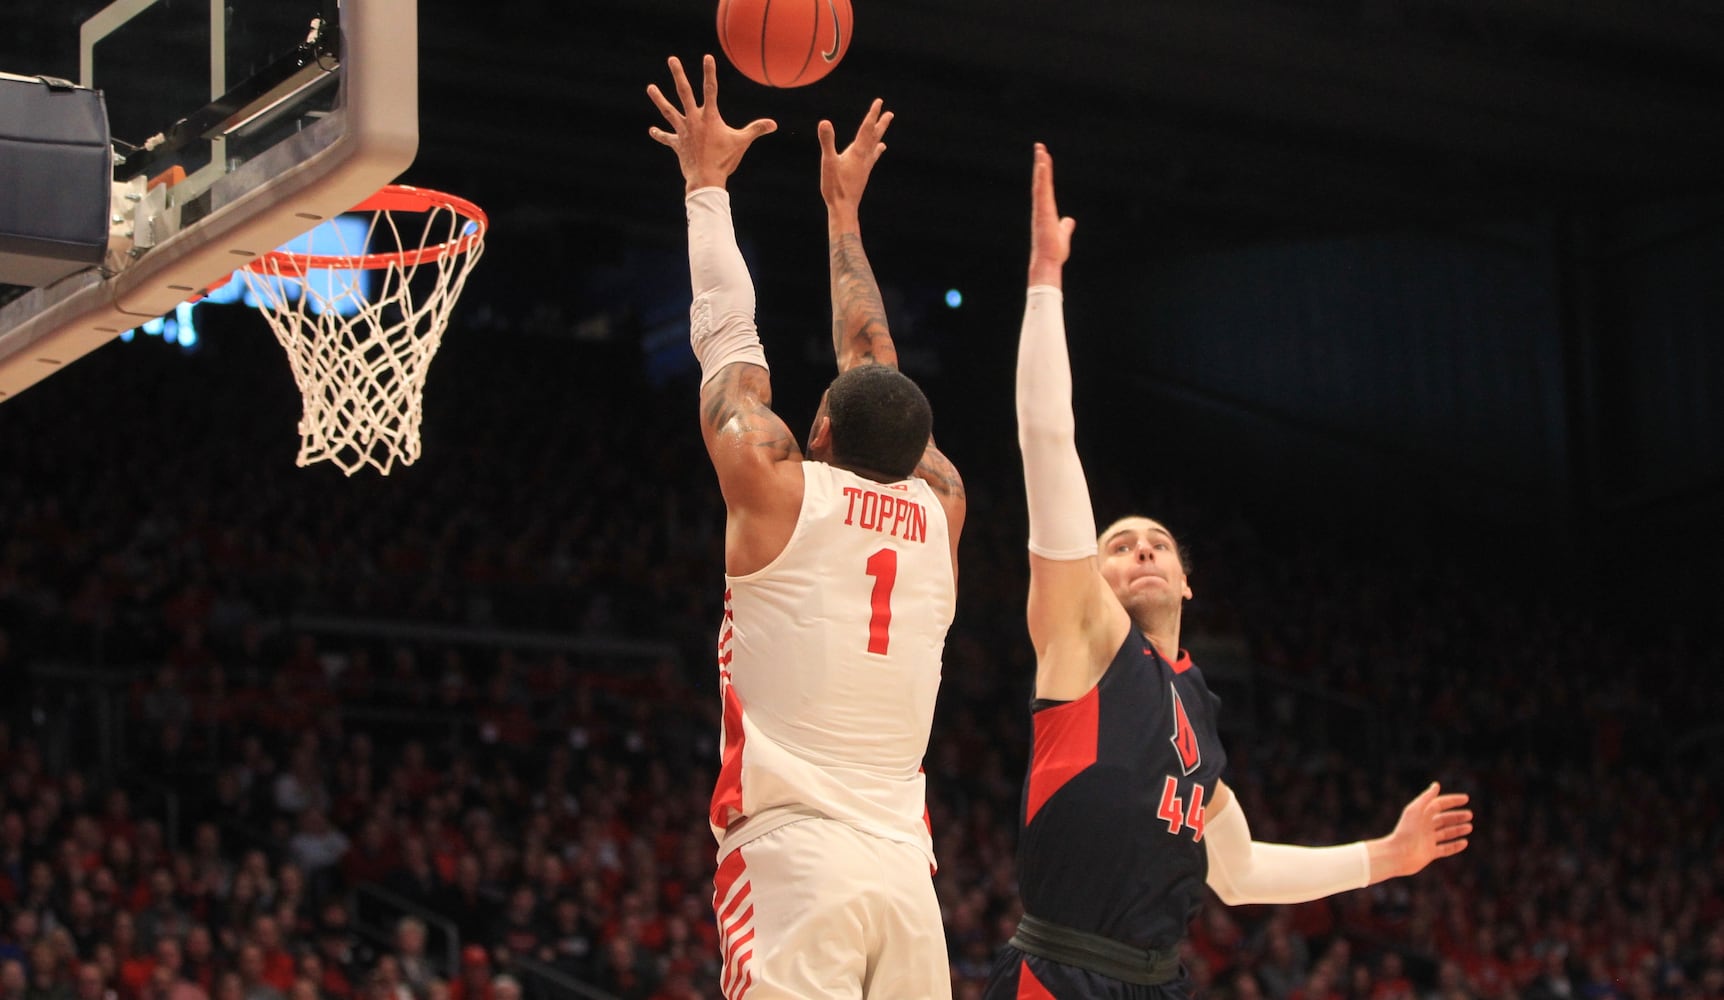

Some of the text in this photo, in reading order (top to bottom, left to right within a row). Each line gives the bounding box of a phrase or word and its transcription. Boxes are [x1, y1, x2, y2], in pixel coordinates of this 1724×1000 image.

[843, 487, 927, 544] TOPPIN
[865, 547, 897, 656] 1
[1157, 775, 1206, 843] 44
